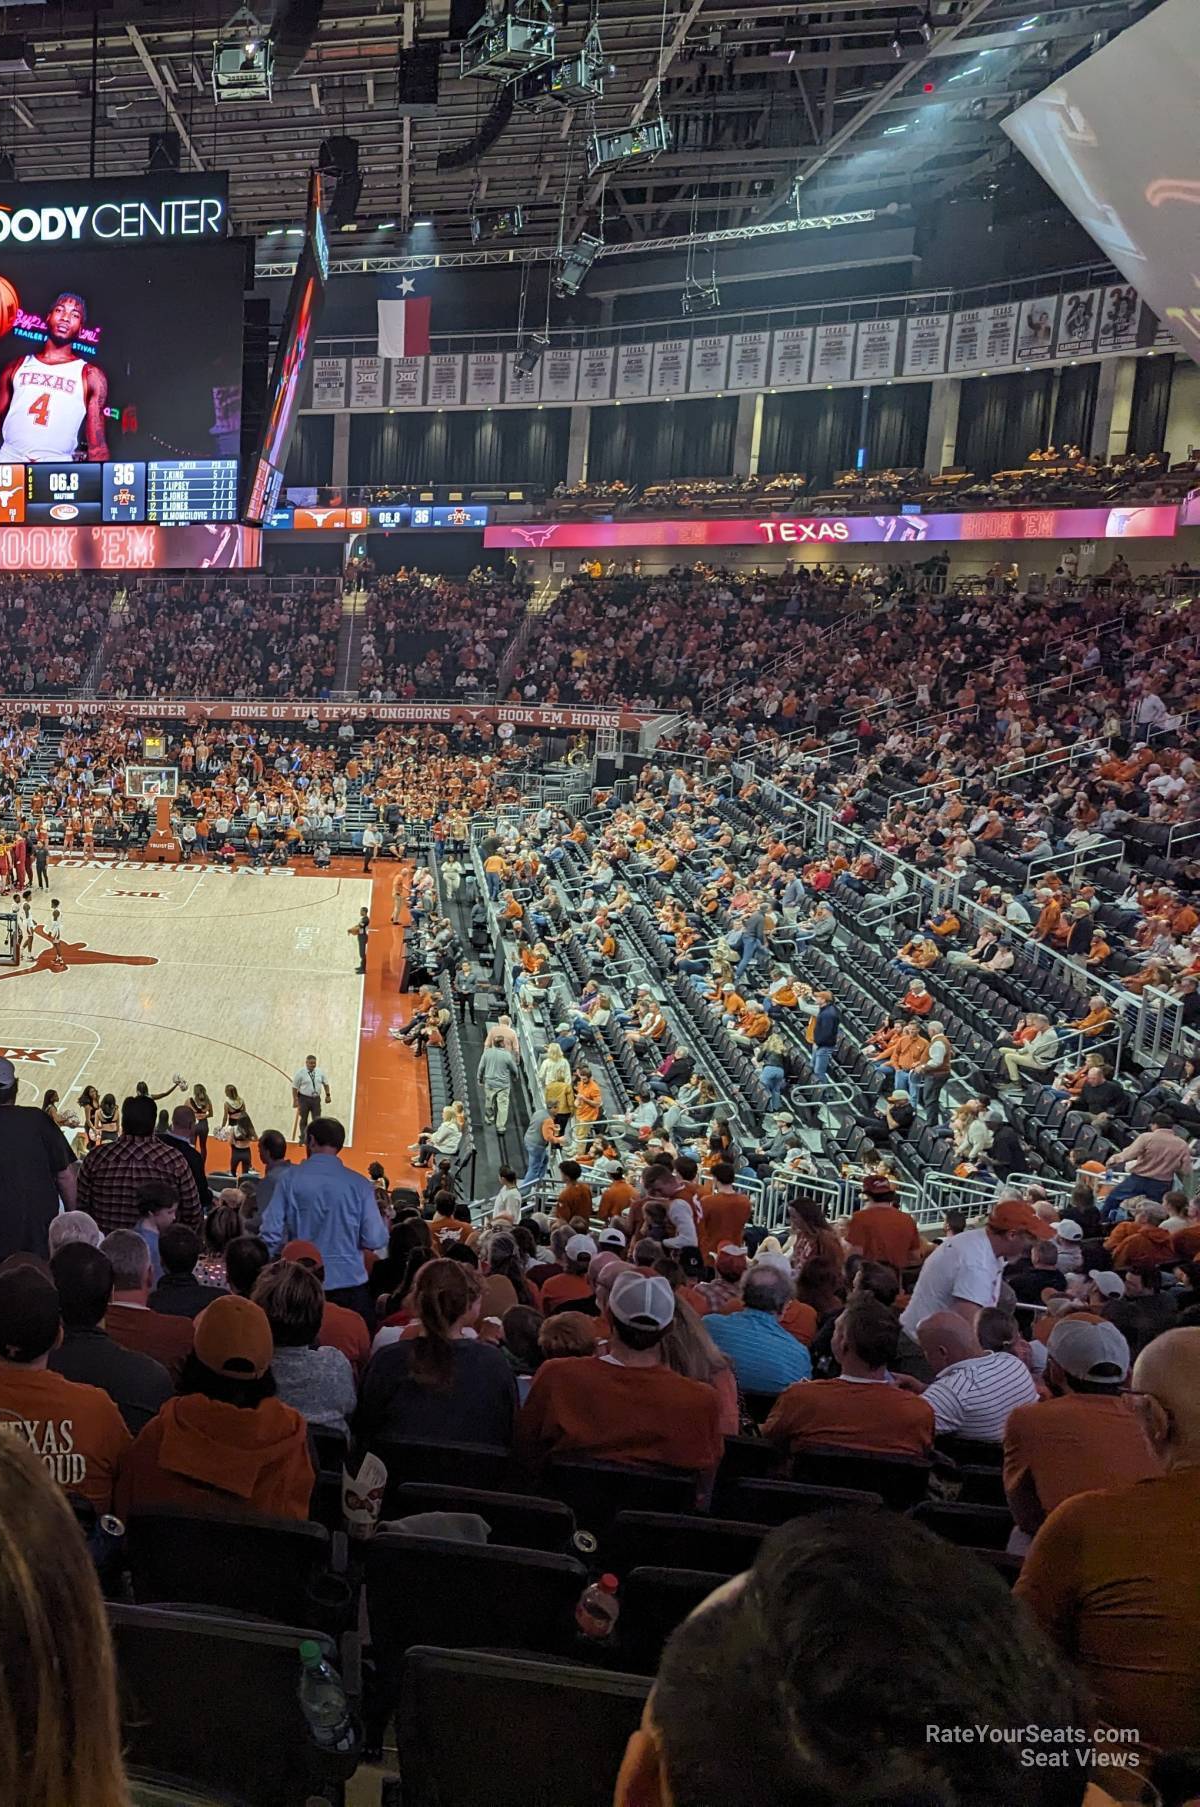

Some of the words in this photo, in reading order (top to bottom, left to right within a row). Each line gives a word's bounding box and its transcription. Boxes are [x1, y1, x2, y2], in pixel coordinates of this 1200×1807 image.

[92, 199, 222, 238] CENTER
[14, 328, 42, 340] TRAILER
[73, 343, 96, 354] STIVAL
[20, 373, 76, 393] TEXAS
[28, 393, 50, 425] 4
[50, 473, 79, 491] 06.8
[114, 463, 134, 485] 36
[163, 471, 184, 480] T.KING
[163, 512, 208, 520] M.MOMCILOVIC
[351, 511, 362, 524] 19
[379, 512, 400, 523] 06.8
[415, 510, 429, 523] 36
[962, 512, 1012, 537] HOOK
[760, 522, 849, 542] TEXAS
[92, 528, 155, 568] 'EM
[56, 704, 73, 714] TO
[130, 705, 186, 716] CENTER
[231, 705, 267, 717] HOME
[272, 706, 288, 717] OF
[292, 706, 319, 717] THE
[371, 707, 450, 720] LONGHORNS
[498, 709, 534, 722] HOOK
[571, 714, 620, 727] HORNS
[48, 859, 297, 876] ONGHORNS
[42, 1454, 87, 1484] OUD
